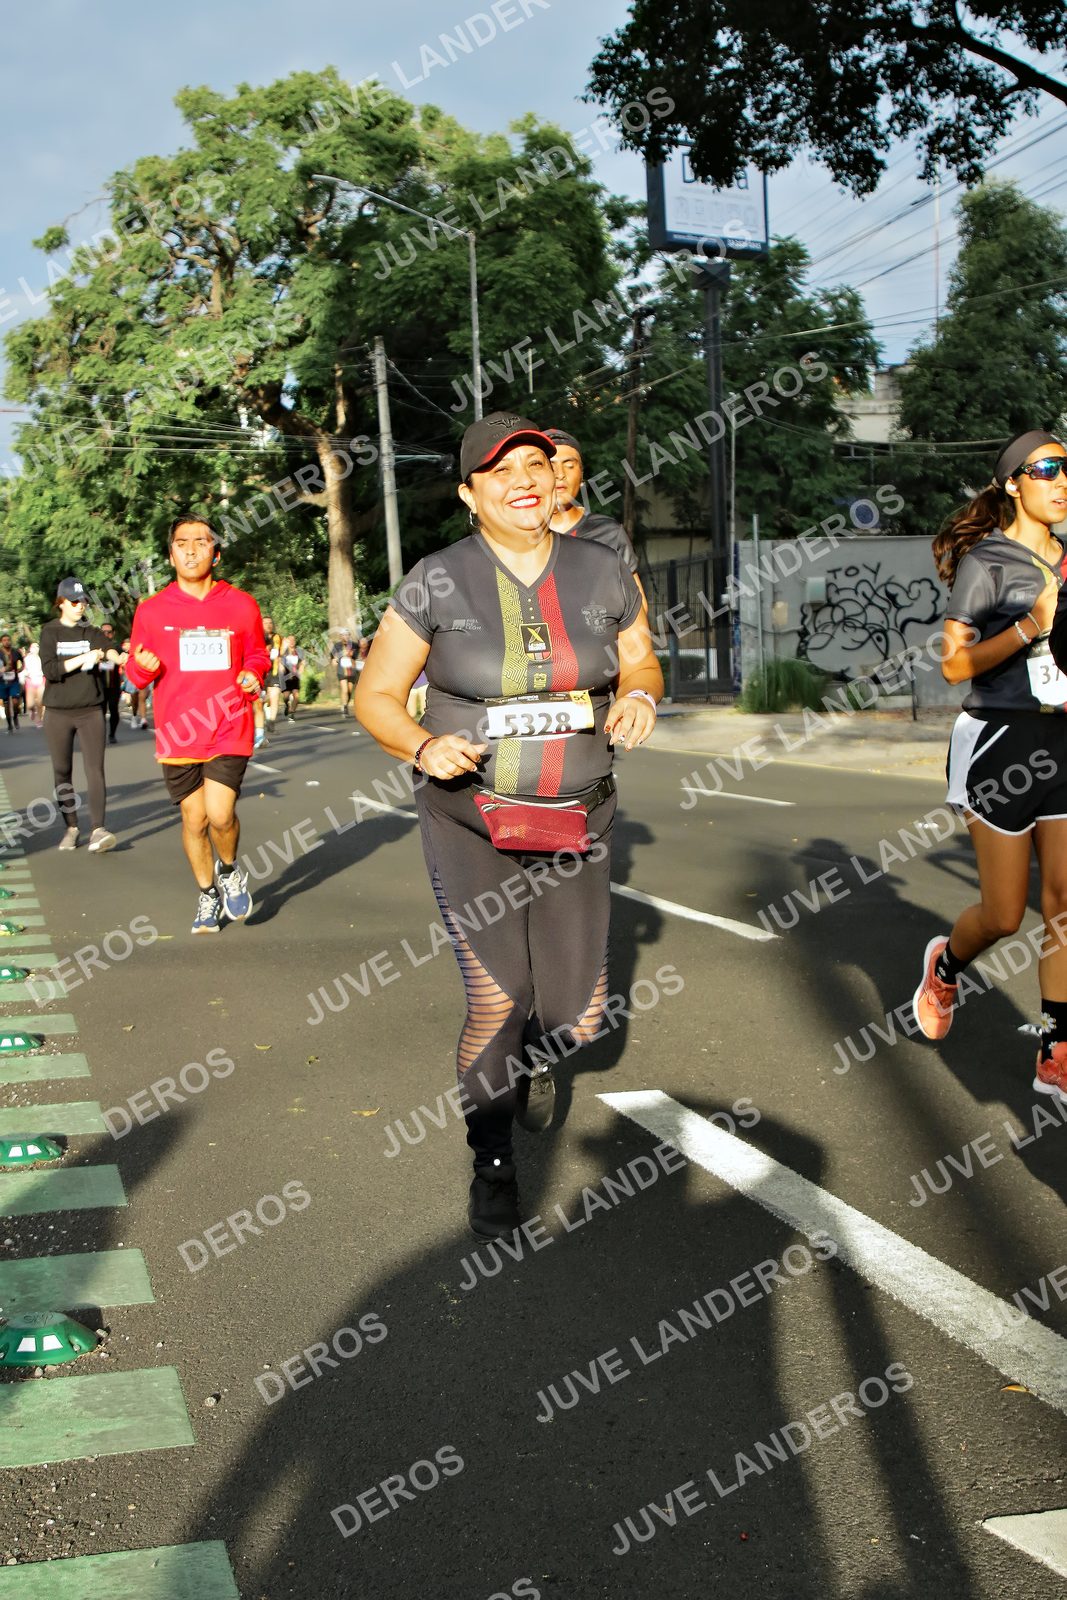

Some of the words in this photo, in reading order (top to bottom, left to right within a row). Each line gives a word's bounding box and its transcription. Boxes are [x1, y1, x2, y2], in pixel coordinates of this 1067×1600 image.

[826, 562, 881, 583] TOY
[184, 643, 223, 656] 12363
[504, 712, 572, 736] 5328
